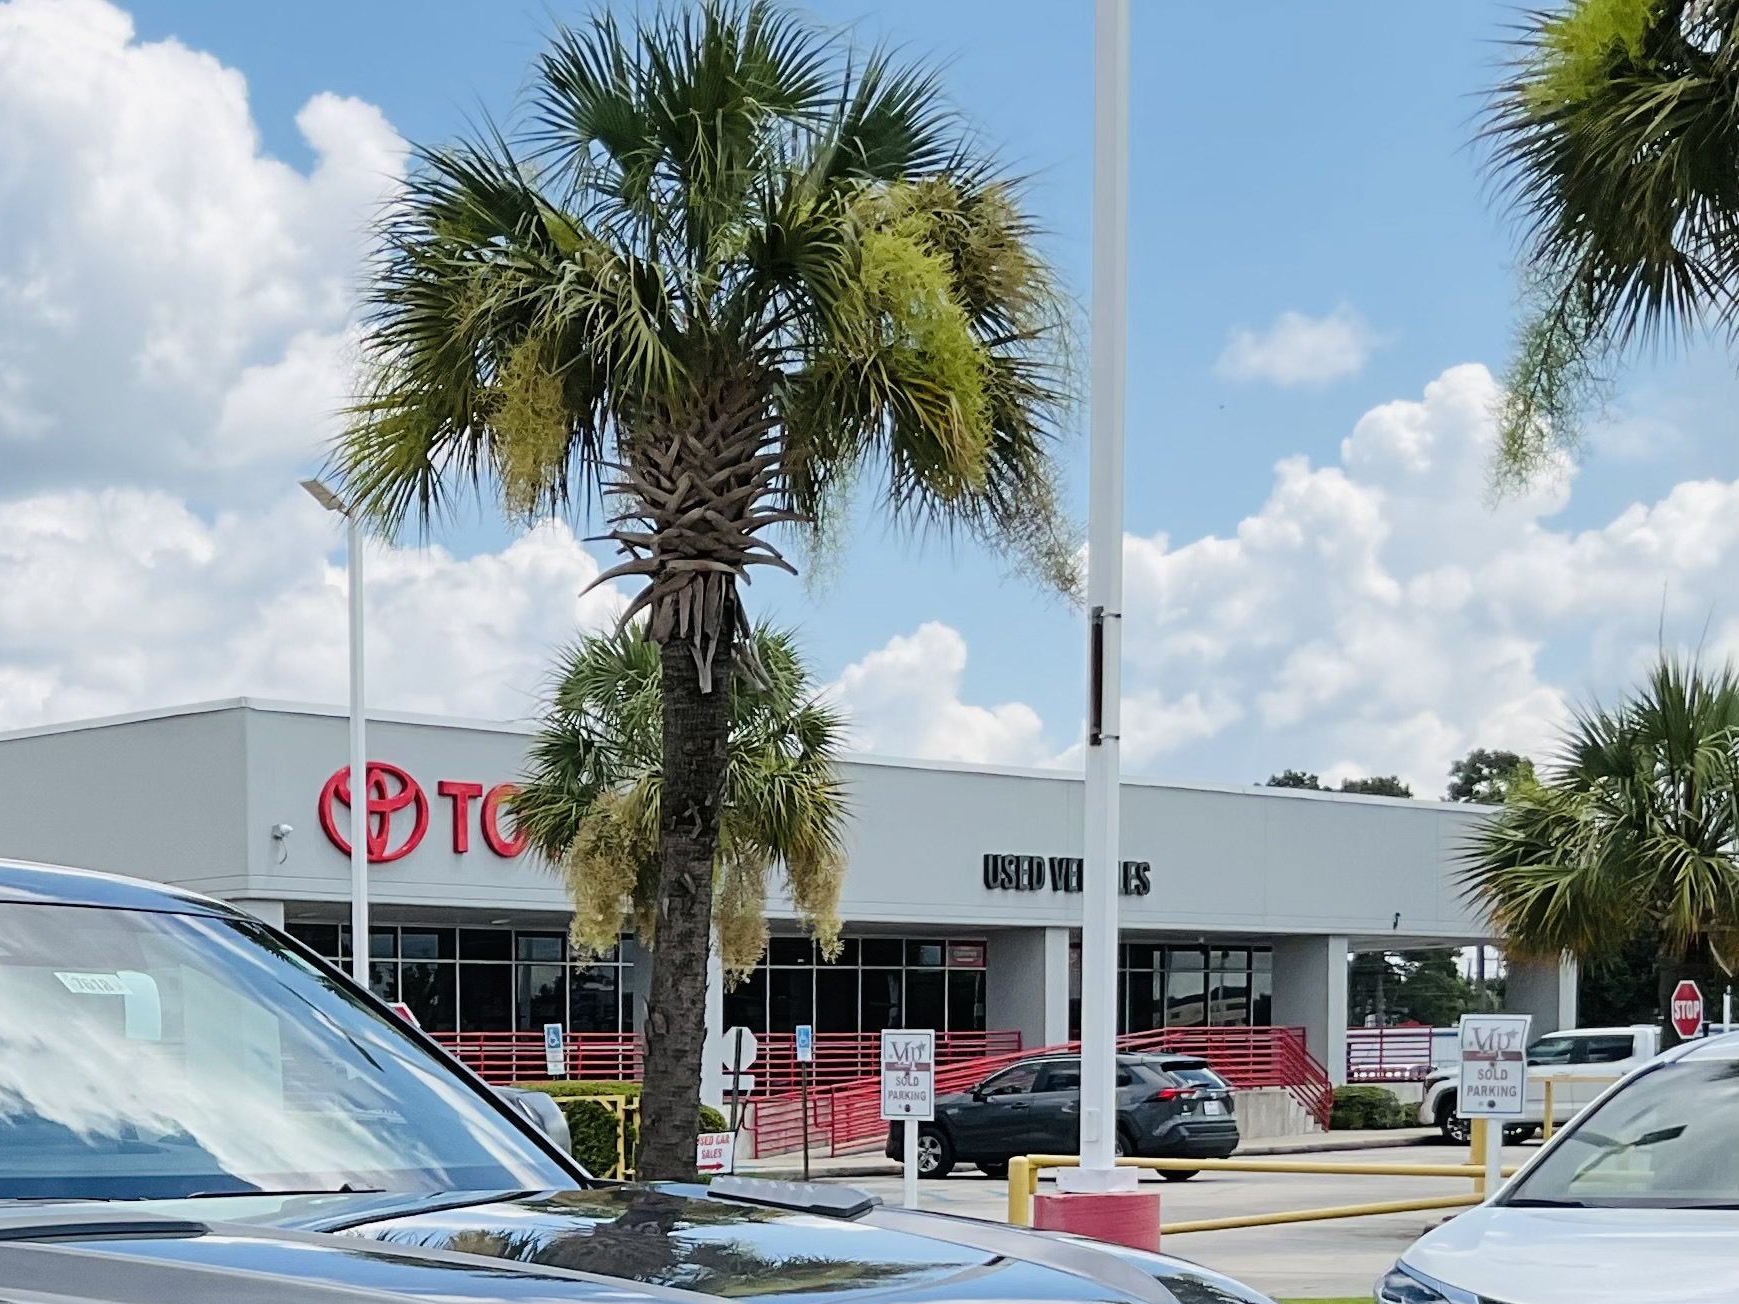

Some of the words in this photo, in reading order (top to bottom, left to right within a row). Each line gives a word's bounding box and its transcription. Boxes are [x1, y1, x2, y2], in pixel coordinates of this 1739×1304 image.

[983, 853, 1046, 891] USED
[1673, 999, 1701, 1020] STOP
[1477, 1068, 1508, 1081] SOLD
[895, 1076, 919, 1087] SOLD
[888, 1090, 926, 1101] PARKING
[1466, 1085, 1517, 1097] PARKING
[716, 1135, 730, 1145] CAR
[701, 1149, 723, 1159] SALES
